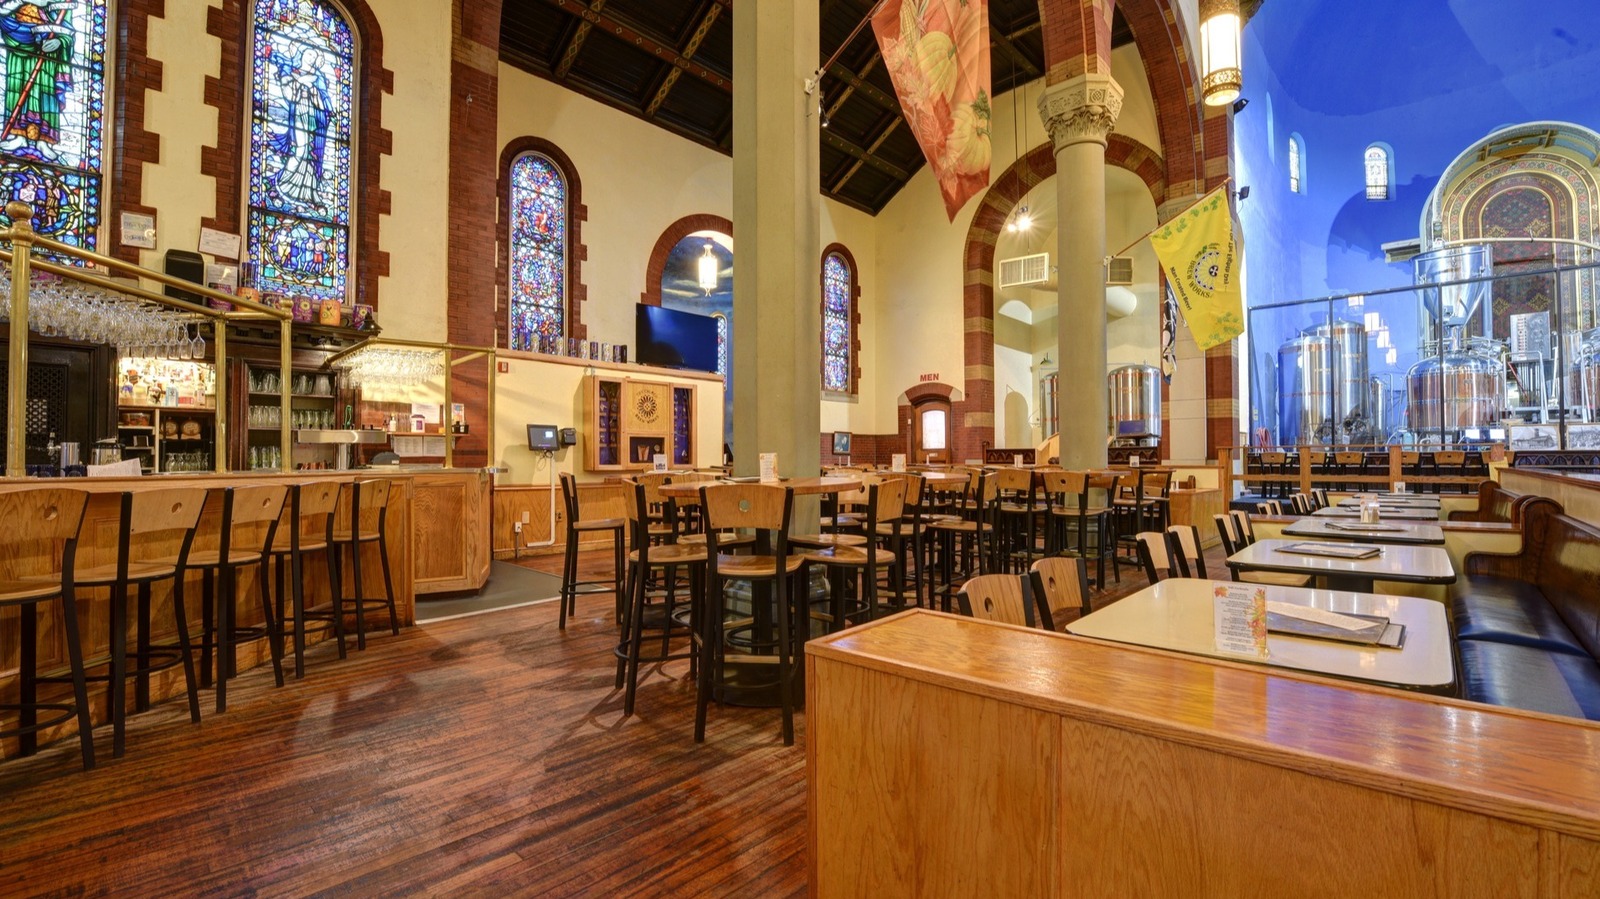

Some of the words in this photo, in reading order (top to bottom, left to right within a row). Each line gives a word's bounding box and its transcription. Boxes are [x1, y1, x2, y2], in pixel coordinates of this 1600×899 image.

[1169, 266, 1177, 277] Man
[1175, 277, 1186, 298] Created
[1188, 280, 1210, 298] WORKS
[920, 373, 940, 382] MEN
